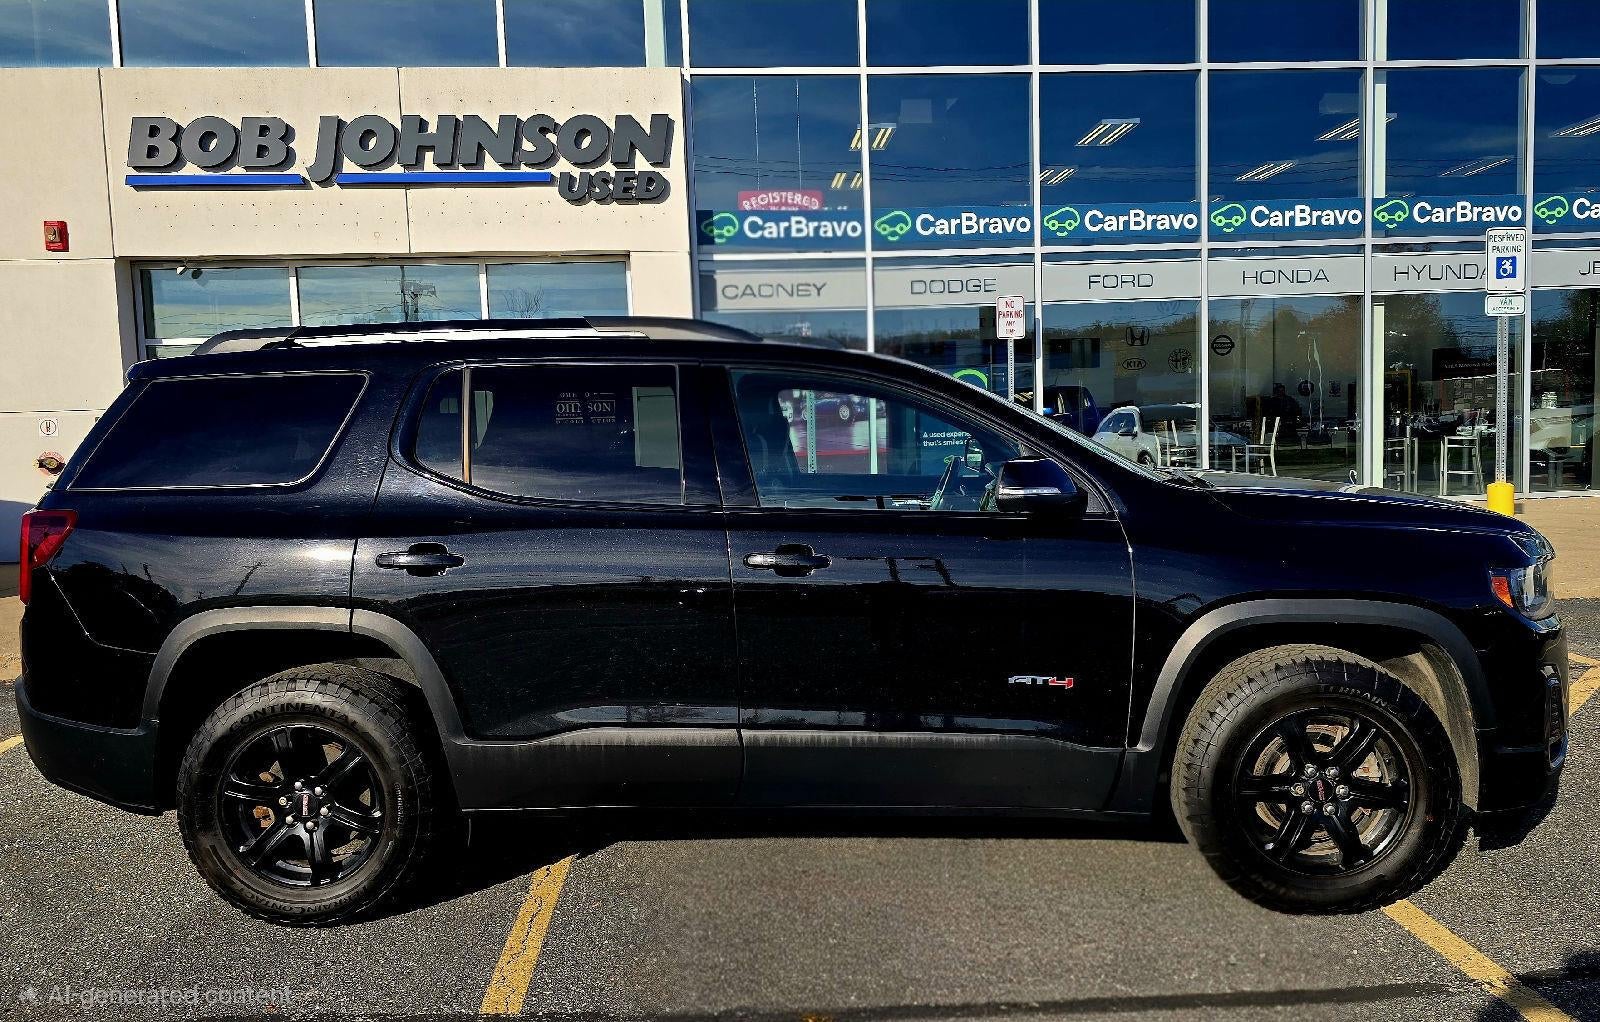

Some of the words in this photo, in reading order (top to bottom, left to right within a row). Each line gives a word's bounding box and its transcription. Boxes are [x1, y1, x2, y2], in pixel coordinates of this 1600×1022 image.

[126, 115, 296, 172] BOB
[306, 113, 675, 187] JOHNSON
[558, 170, 671, 205] USED
[1084, 209, 1198, 231] CarBravo
[1250, 204, 1362, 228] CarBravo
[1413, 201, 1522, 223] CarBravo
[743, 215, 862, 239] CarBravo
[915, 212, 1031, 236] CarBravo
[1488, 233, 1525, 243] RESERVED
[1491, 245, 1522, 254] PARKING
[910, 277, 997, 295] DODGE
[1088, 273, 1154, 289] FORD
[1242, 269, 1330, 285] HONDA
[998, 309, 1023, 319] PARKING
[1005, 300, 1015, 309] NO
[1126, 360, 1143, 368] KIA
[230, 702, 360, 734] CONTINENTAL
